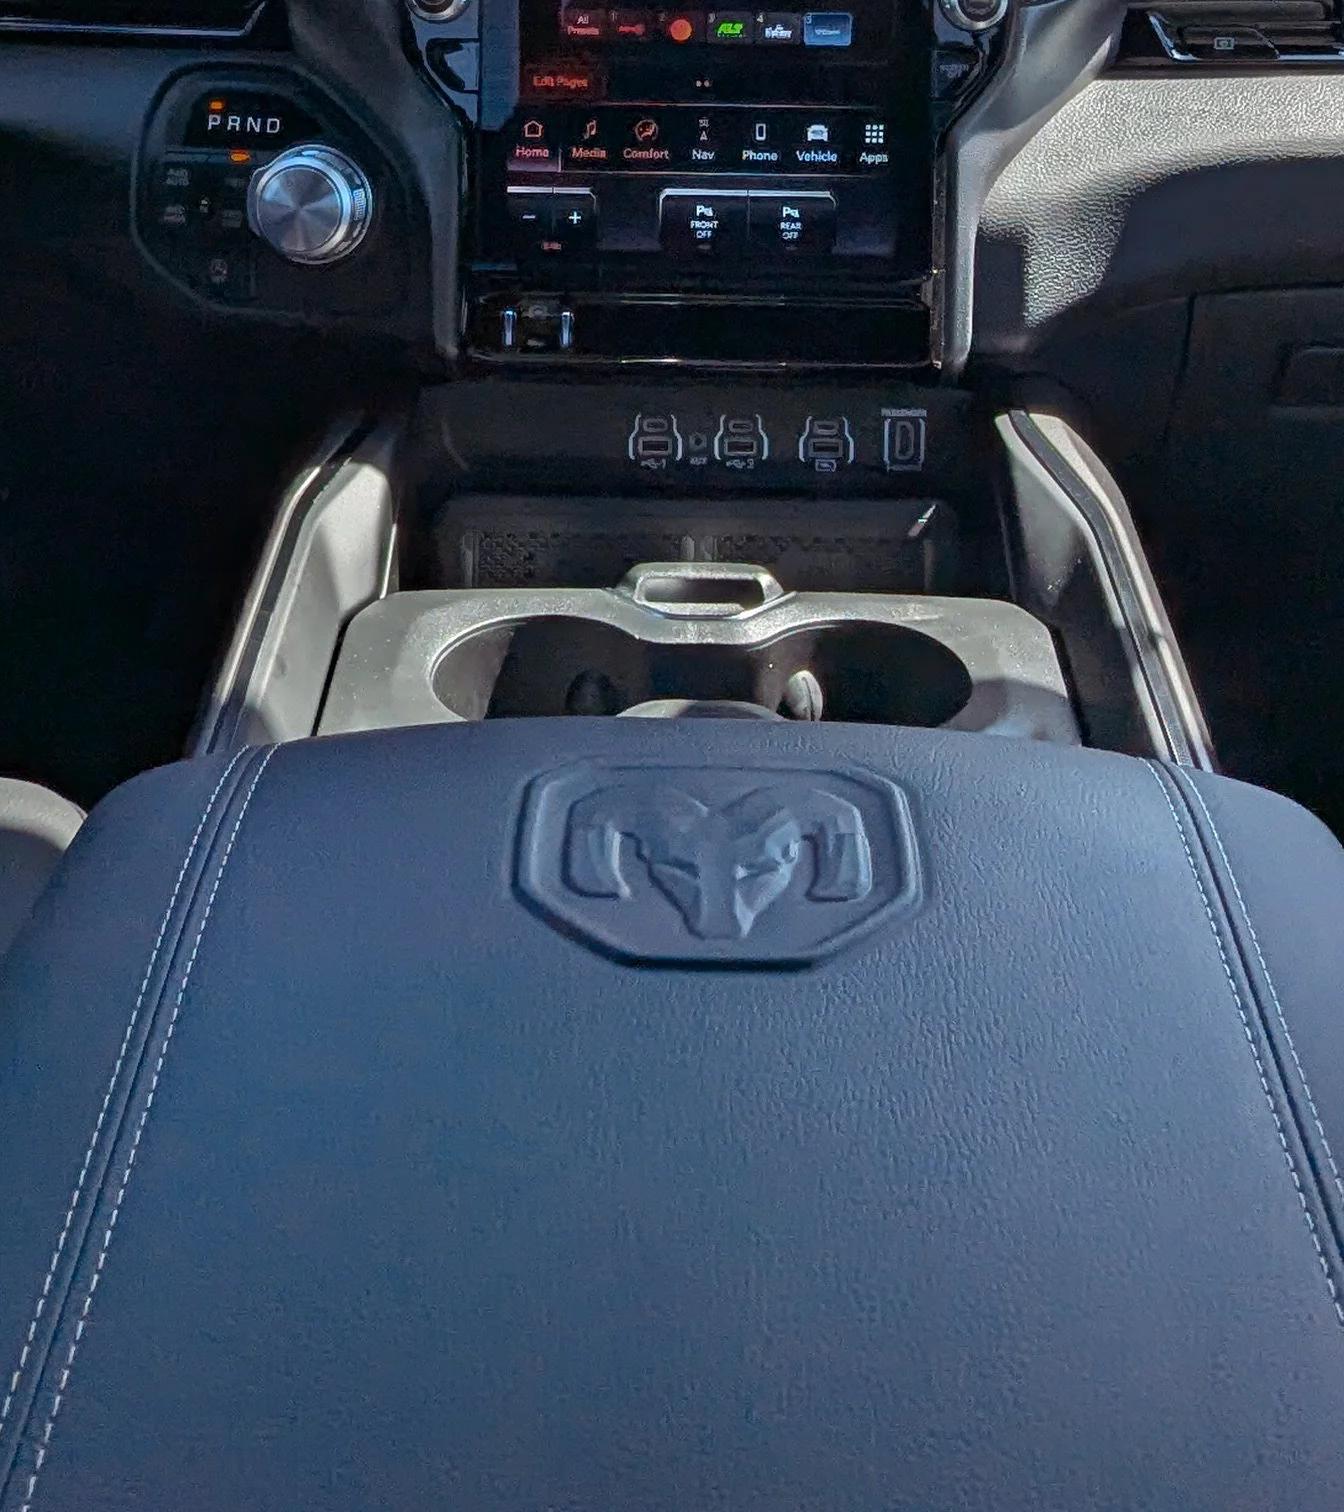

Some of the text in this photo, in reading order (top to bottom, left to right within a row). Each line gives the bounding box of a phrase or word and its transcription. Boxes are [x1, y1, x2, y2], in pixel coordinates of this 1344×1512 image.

[532, 75, 554, 88] Edit
[208, 114, 281, 134] P R N D
[515, 146, 550, 158] Home
[571, 147, 606, 159] Media
[622, 147, 670, 160] Comfort
[691, 149, 716, 161] Nav
[742, 149, 778, 162] Phone
[795, 149, 838, 163] Vehicle
[858, 151, 889, 165] Apps
[690, 219, 719, 230] FRONT
[780, 220, 803, 231] REAR
